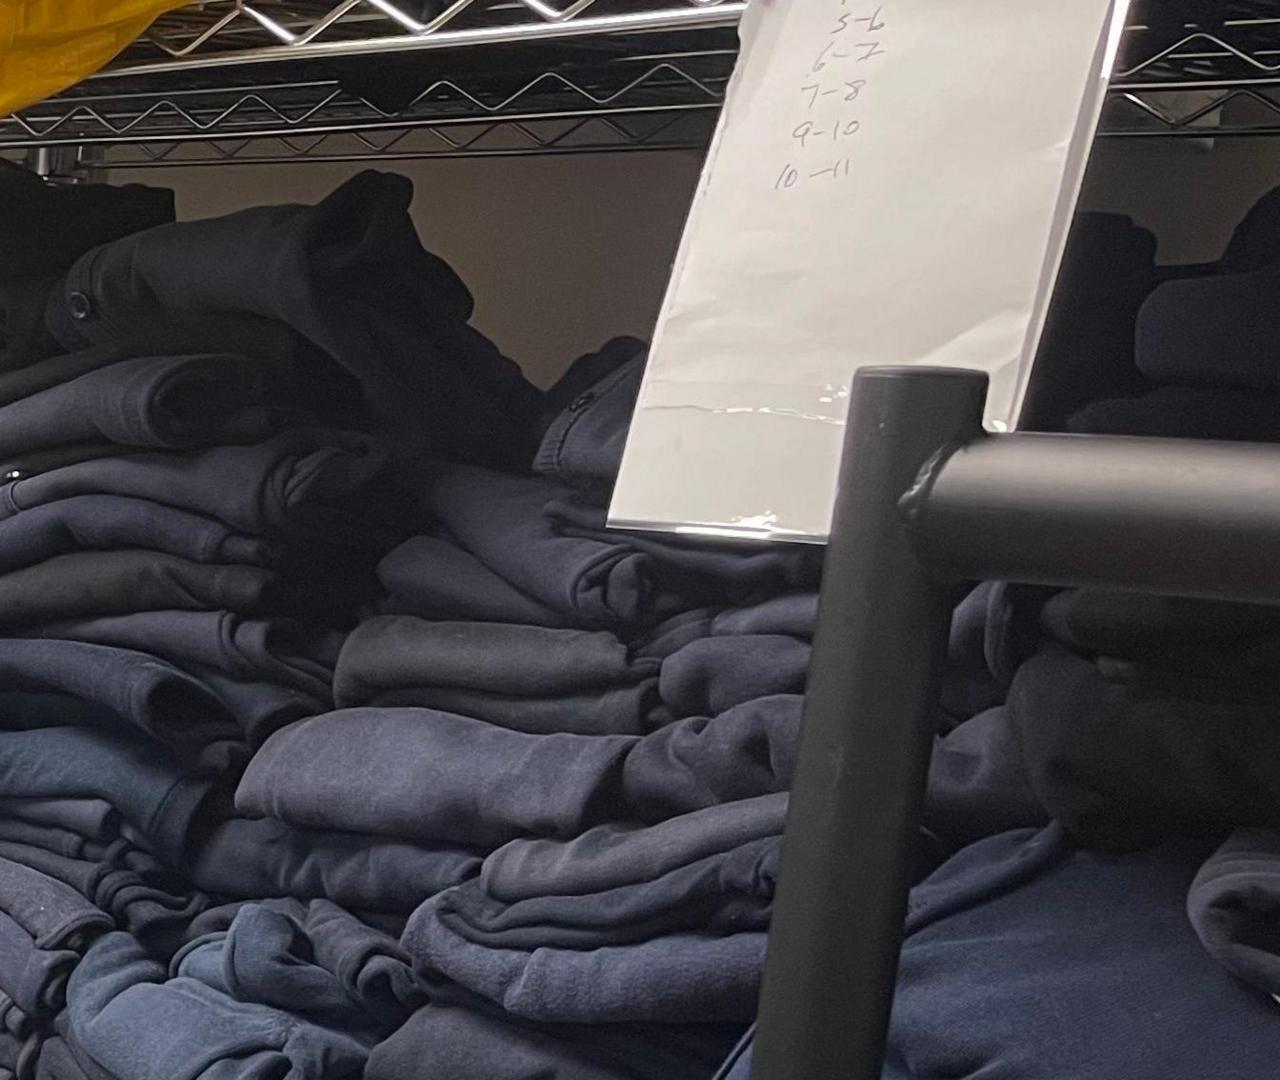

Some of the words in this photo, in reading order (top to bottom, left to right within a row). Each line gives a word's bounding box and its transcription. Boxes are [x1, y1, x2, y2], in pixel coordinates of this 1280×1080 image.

[831, 6, 885, 34] 5-6
[813, 41, 885, 72] 6-7
[801, 80, 866, 109] 7-8
[792, 120, 859, 147] 9-10
